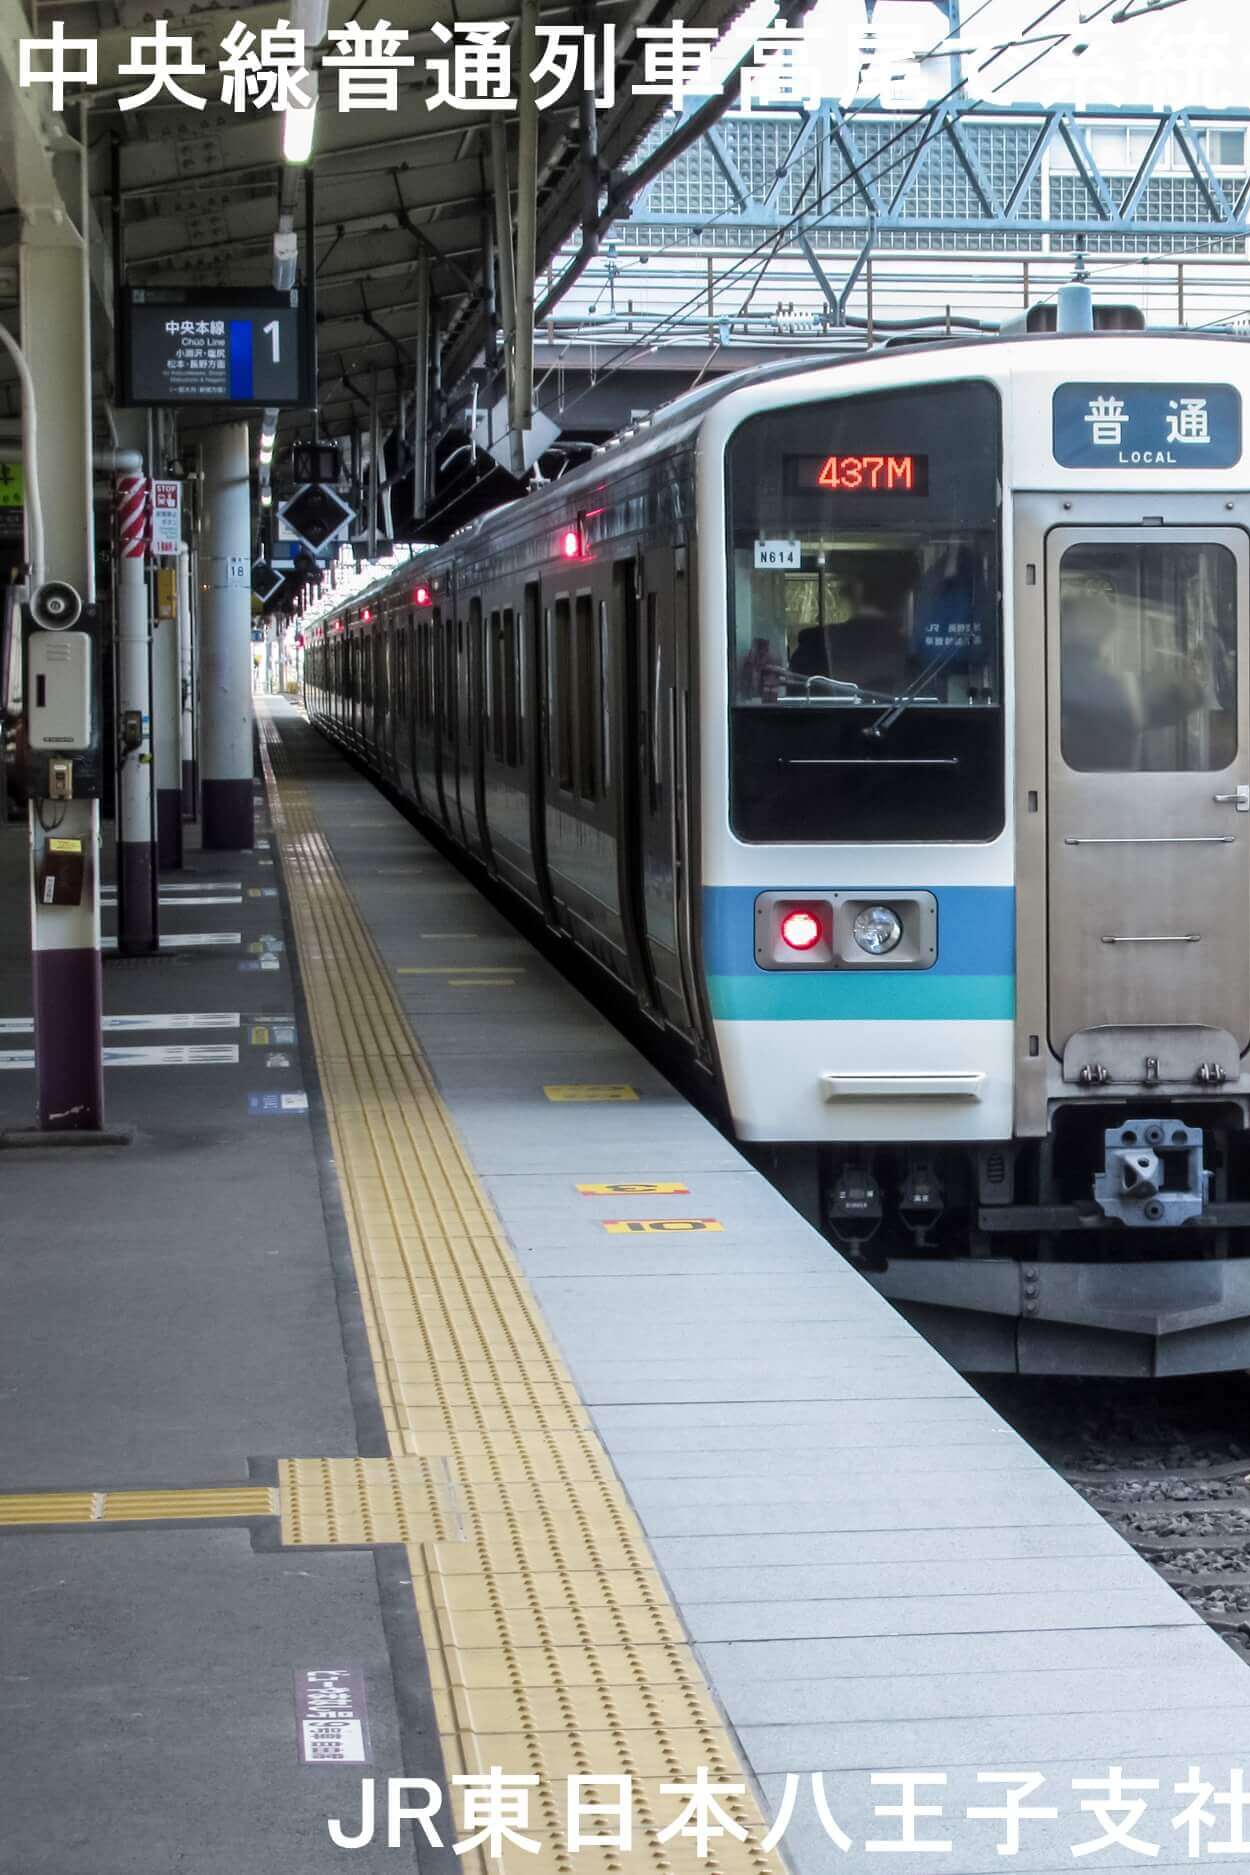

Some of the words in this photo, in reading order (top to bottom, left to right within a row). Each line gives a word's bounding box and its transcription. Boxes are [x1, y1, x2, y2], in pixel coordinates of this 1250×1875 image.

[165, 320, 225, 336] 中央本線
[207, 337, 226, 347] Line
[263, 320, 281, 364] 1
[1119, 451, 1177, 464] LOCAL
[818, 456, 914, 489] 437M
[156, 484, 178, 493] STOP
[760, 551, 795, 563] N614
[231, 566, 244, 577] 18
[305, 1670, 354, 1718] ビューやまなし号
